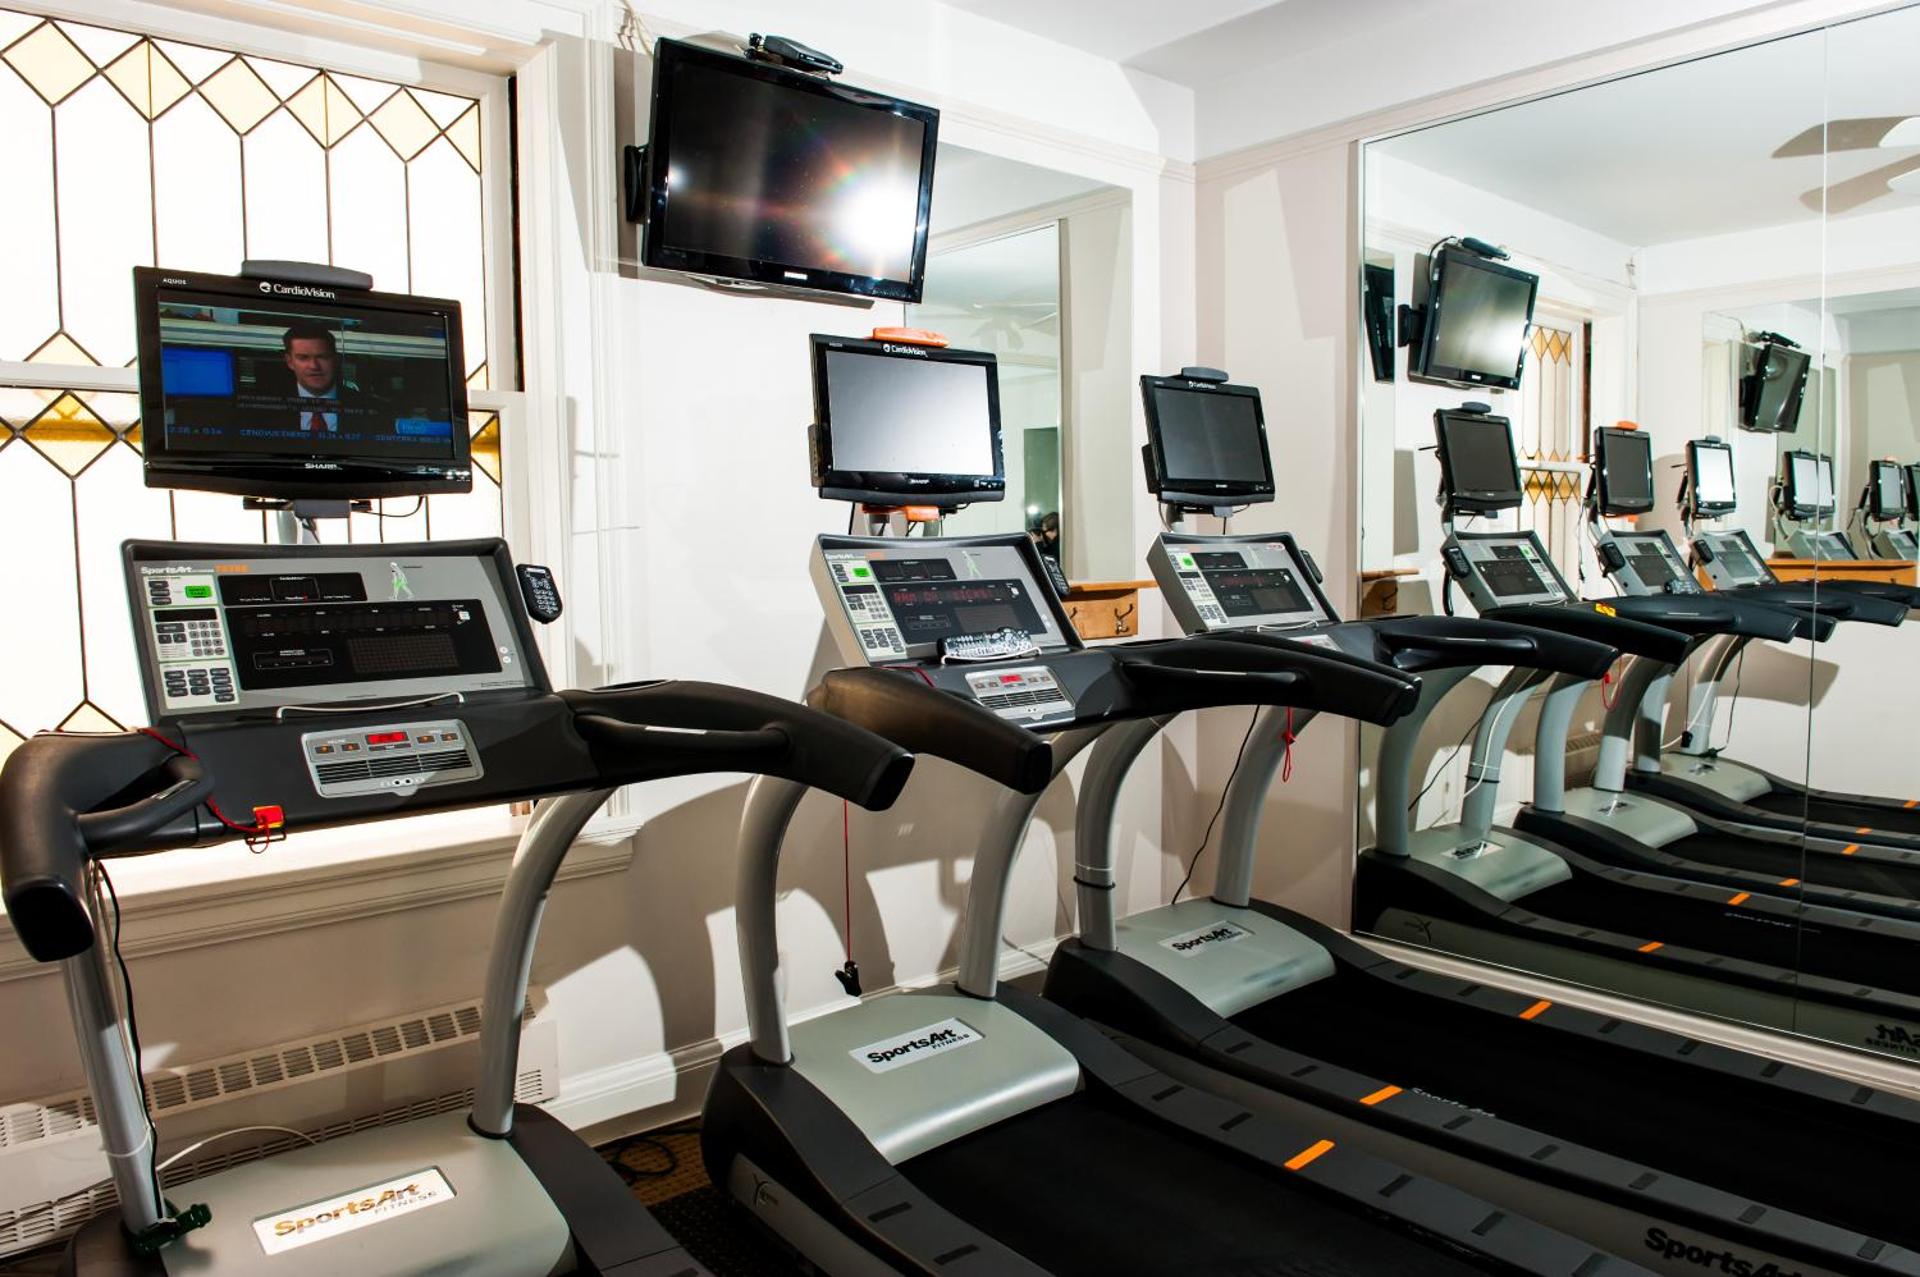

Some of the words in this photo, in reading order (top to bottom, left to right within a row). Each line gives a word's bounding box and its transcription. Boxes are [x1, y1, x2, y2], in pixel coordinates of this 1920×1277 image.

[273, 283, 336, 300] CardioVision
[305, 462, 338, 470] SHARP
[1172, 928, 1233, 951] SportsArt
[867, 1028, 957, 1063] SportsArt
[932, 1033, 971, 1050] FITNESS
[274, 1183, 420, 1236] SportsArt
